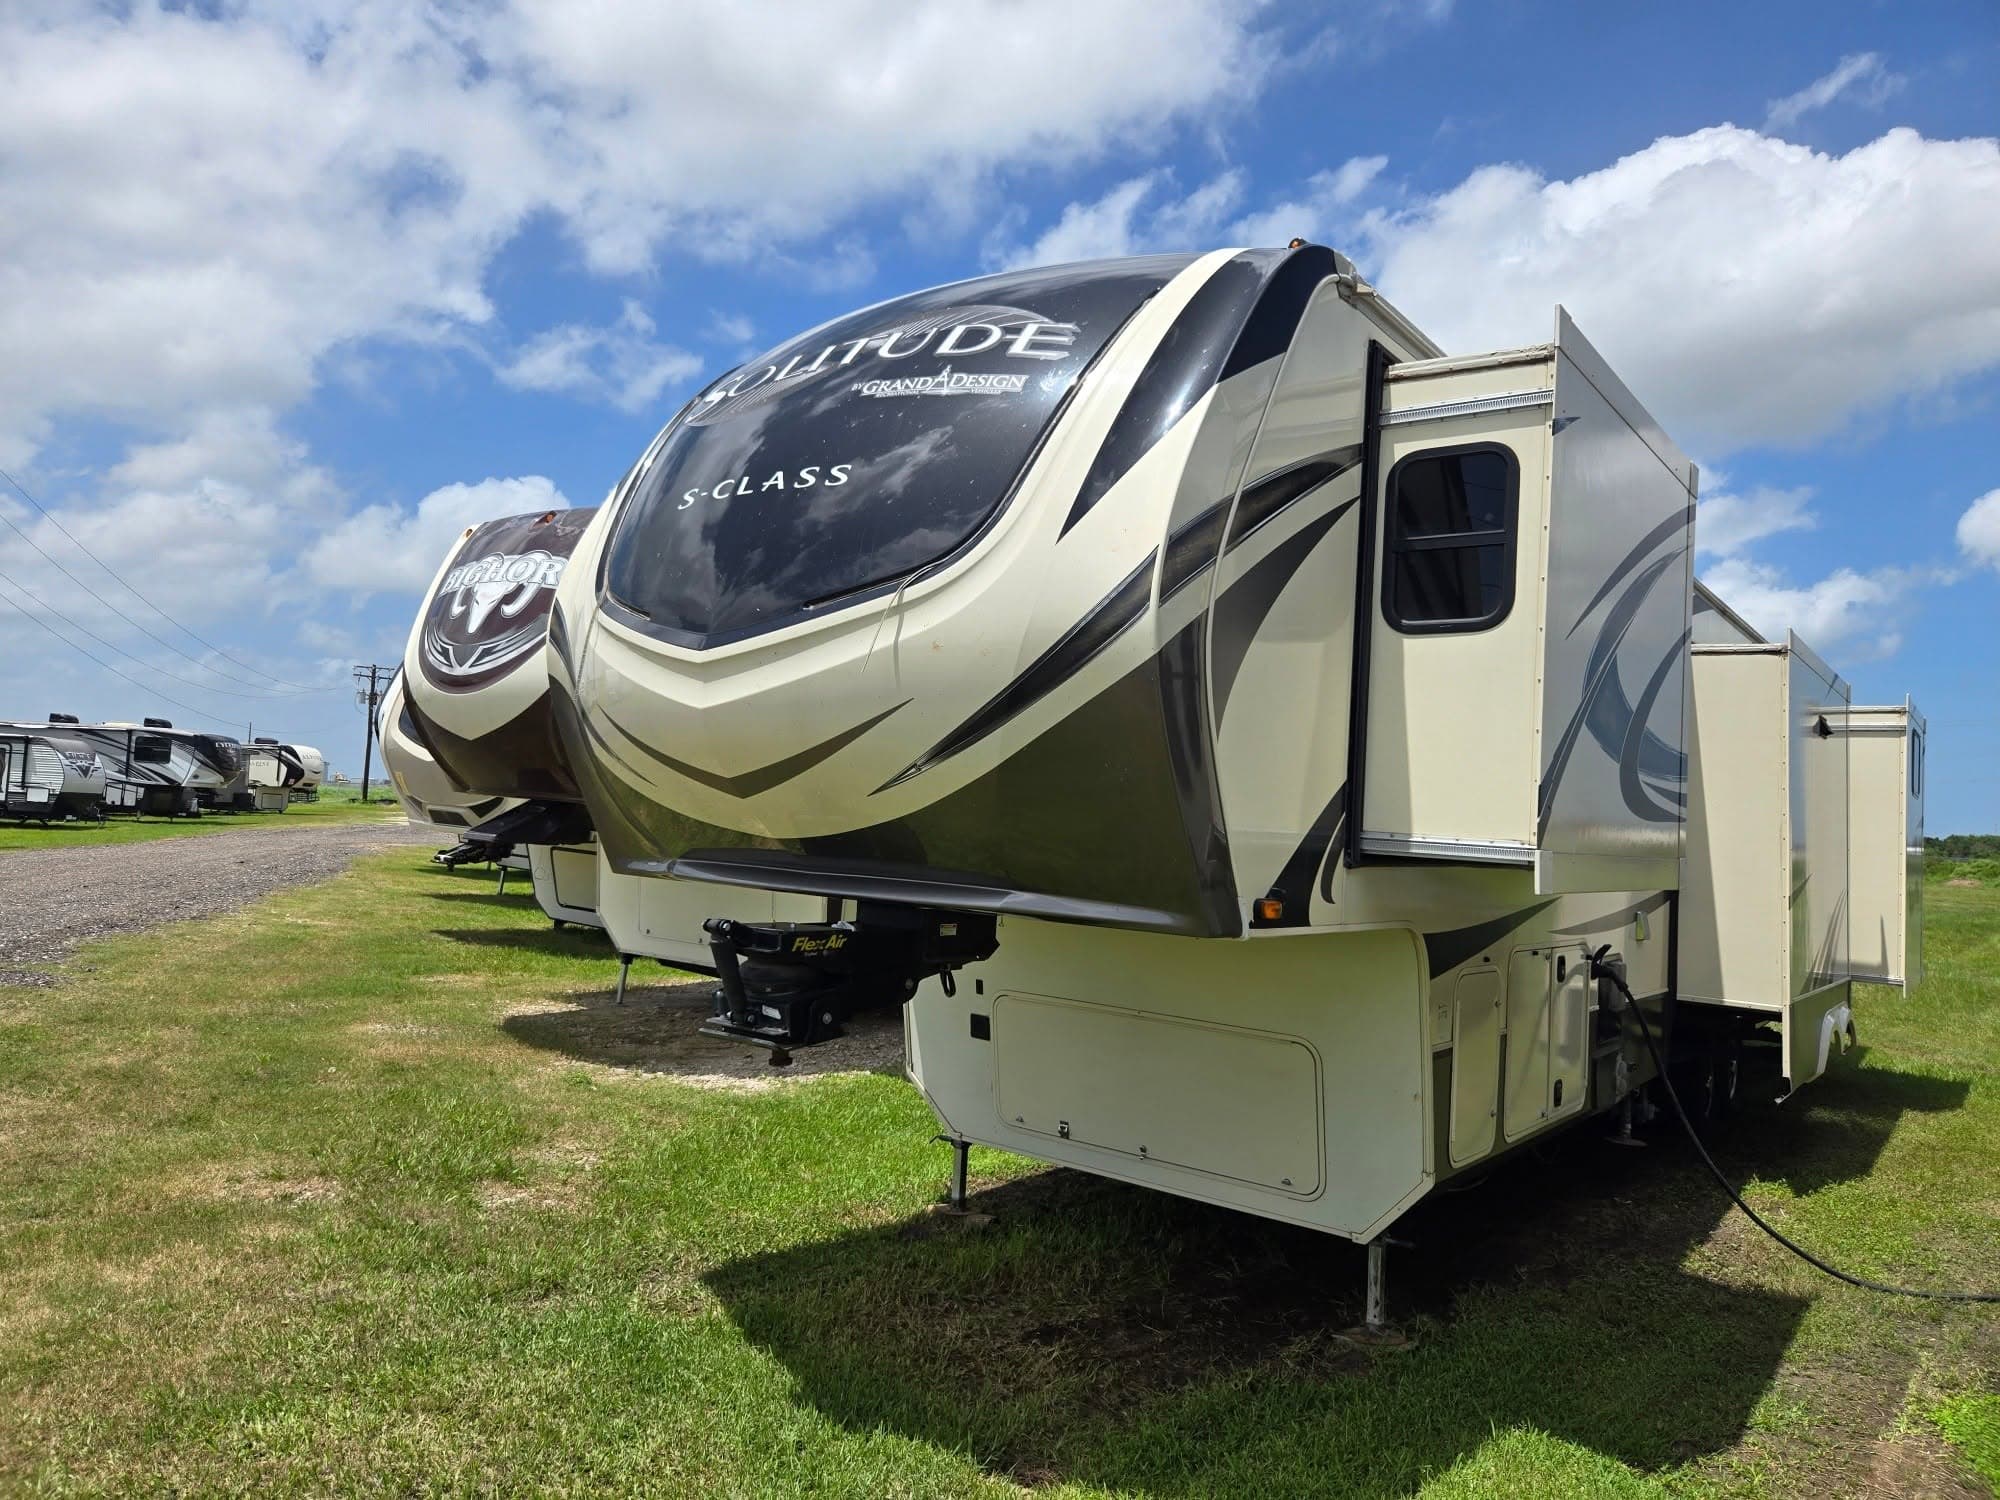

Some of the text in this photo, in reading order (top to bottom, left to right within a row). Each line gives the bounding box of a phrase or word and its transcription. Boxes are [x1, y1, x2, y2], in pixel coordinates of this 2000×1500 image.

[685, 321, 1081, 424] SOLITUDE
[851, 374, 1029, 394] BY GRAND DESIGN
[677, 464, 852, 510] S-CLASS
[440, 557, 563, 594] BIGHOR
[825, 934, 848, 950] Air
